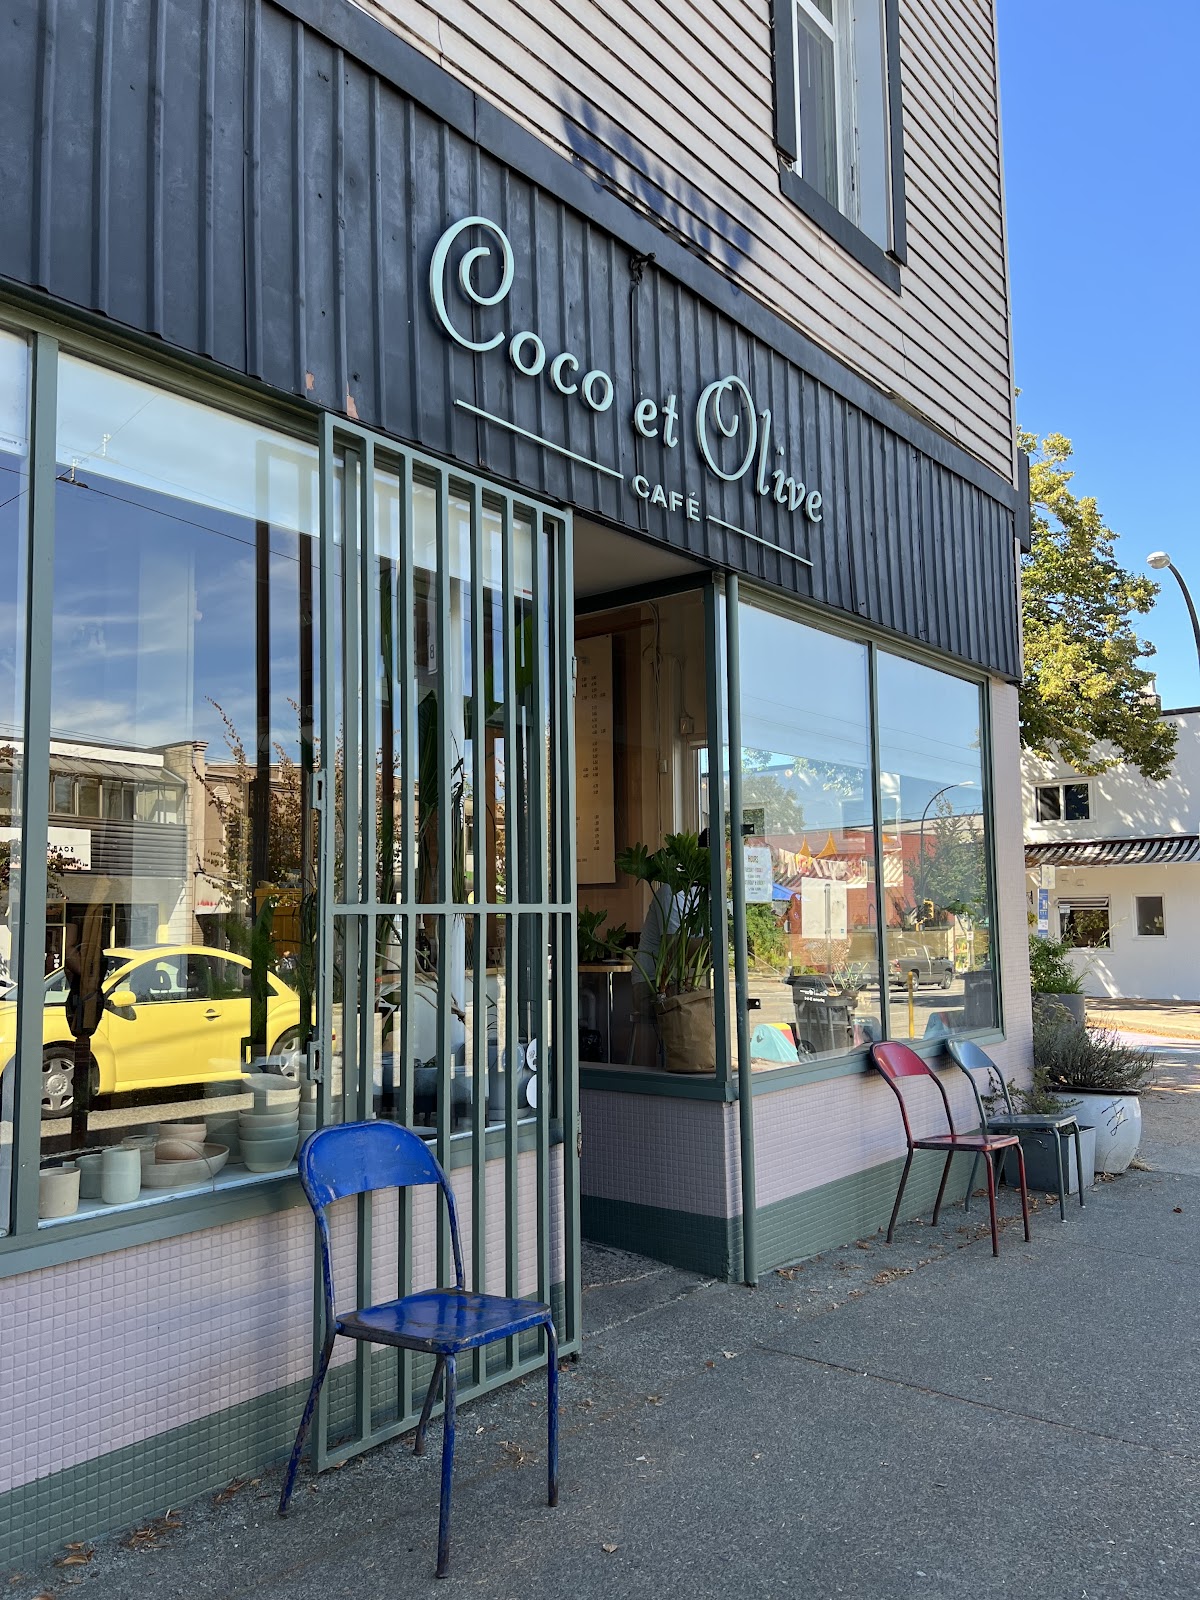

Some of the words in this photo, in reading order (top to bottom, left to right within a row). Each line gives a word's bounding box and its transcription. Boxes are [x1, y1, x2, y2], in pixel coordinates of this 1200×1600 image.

[429, 215, 614, 412] Coco
[633, 394, 679, 448] et
[695, 374, 824, 523] Olive
[630, 474, 701, 522] CAFÉ
